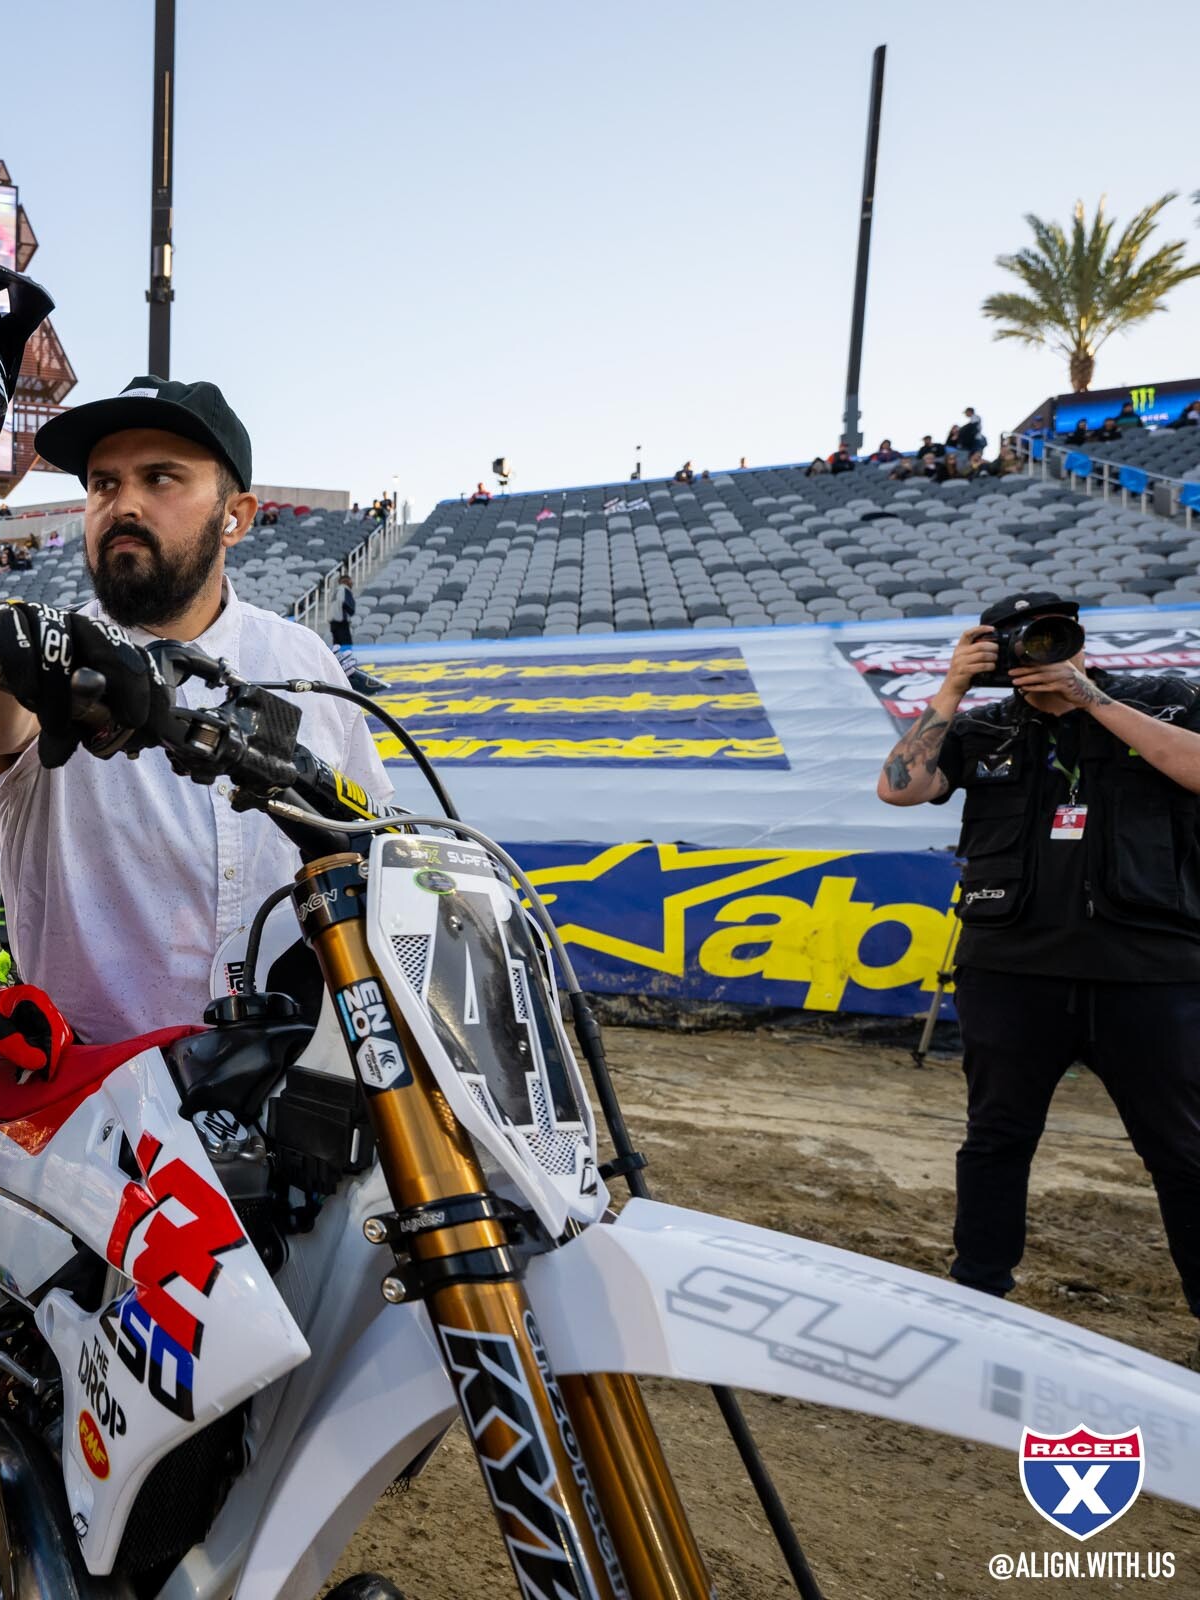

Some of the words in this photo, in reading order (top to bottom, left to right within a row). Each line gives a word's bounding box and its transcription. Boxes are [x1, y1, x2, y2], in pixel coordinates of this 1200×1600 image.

[93, 1335, 109, 1379] THE
[77, 1340, 127, 1440] DROP
[1031, 1374, 1190, 1445] BUDGET
[79, 1418, 106, 1465] FMF
